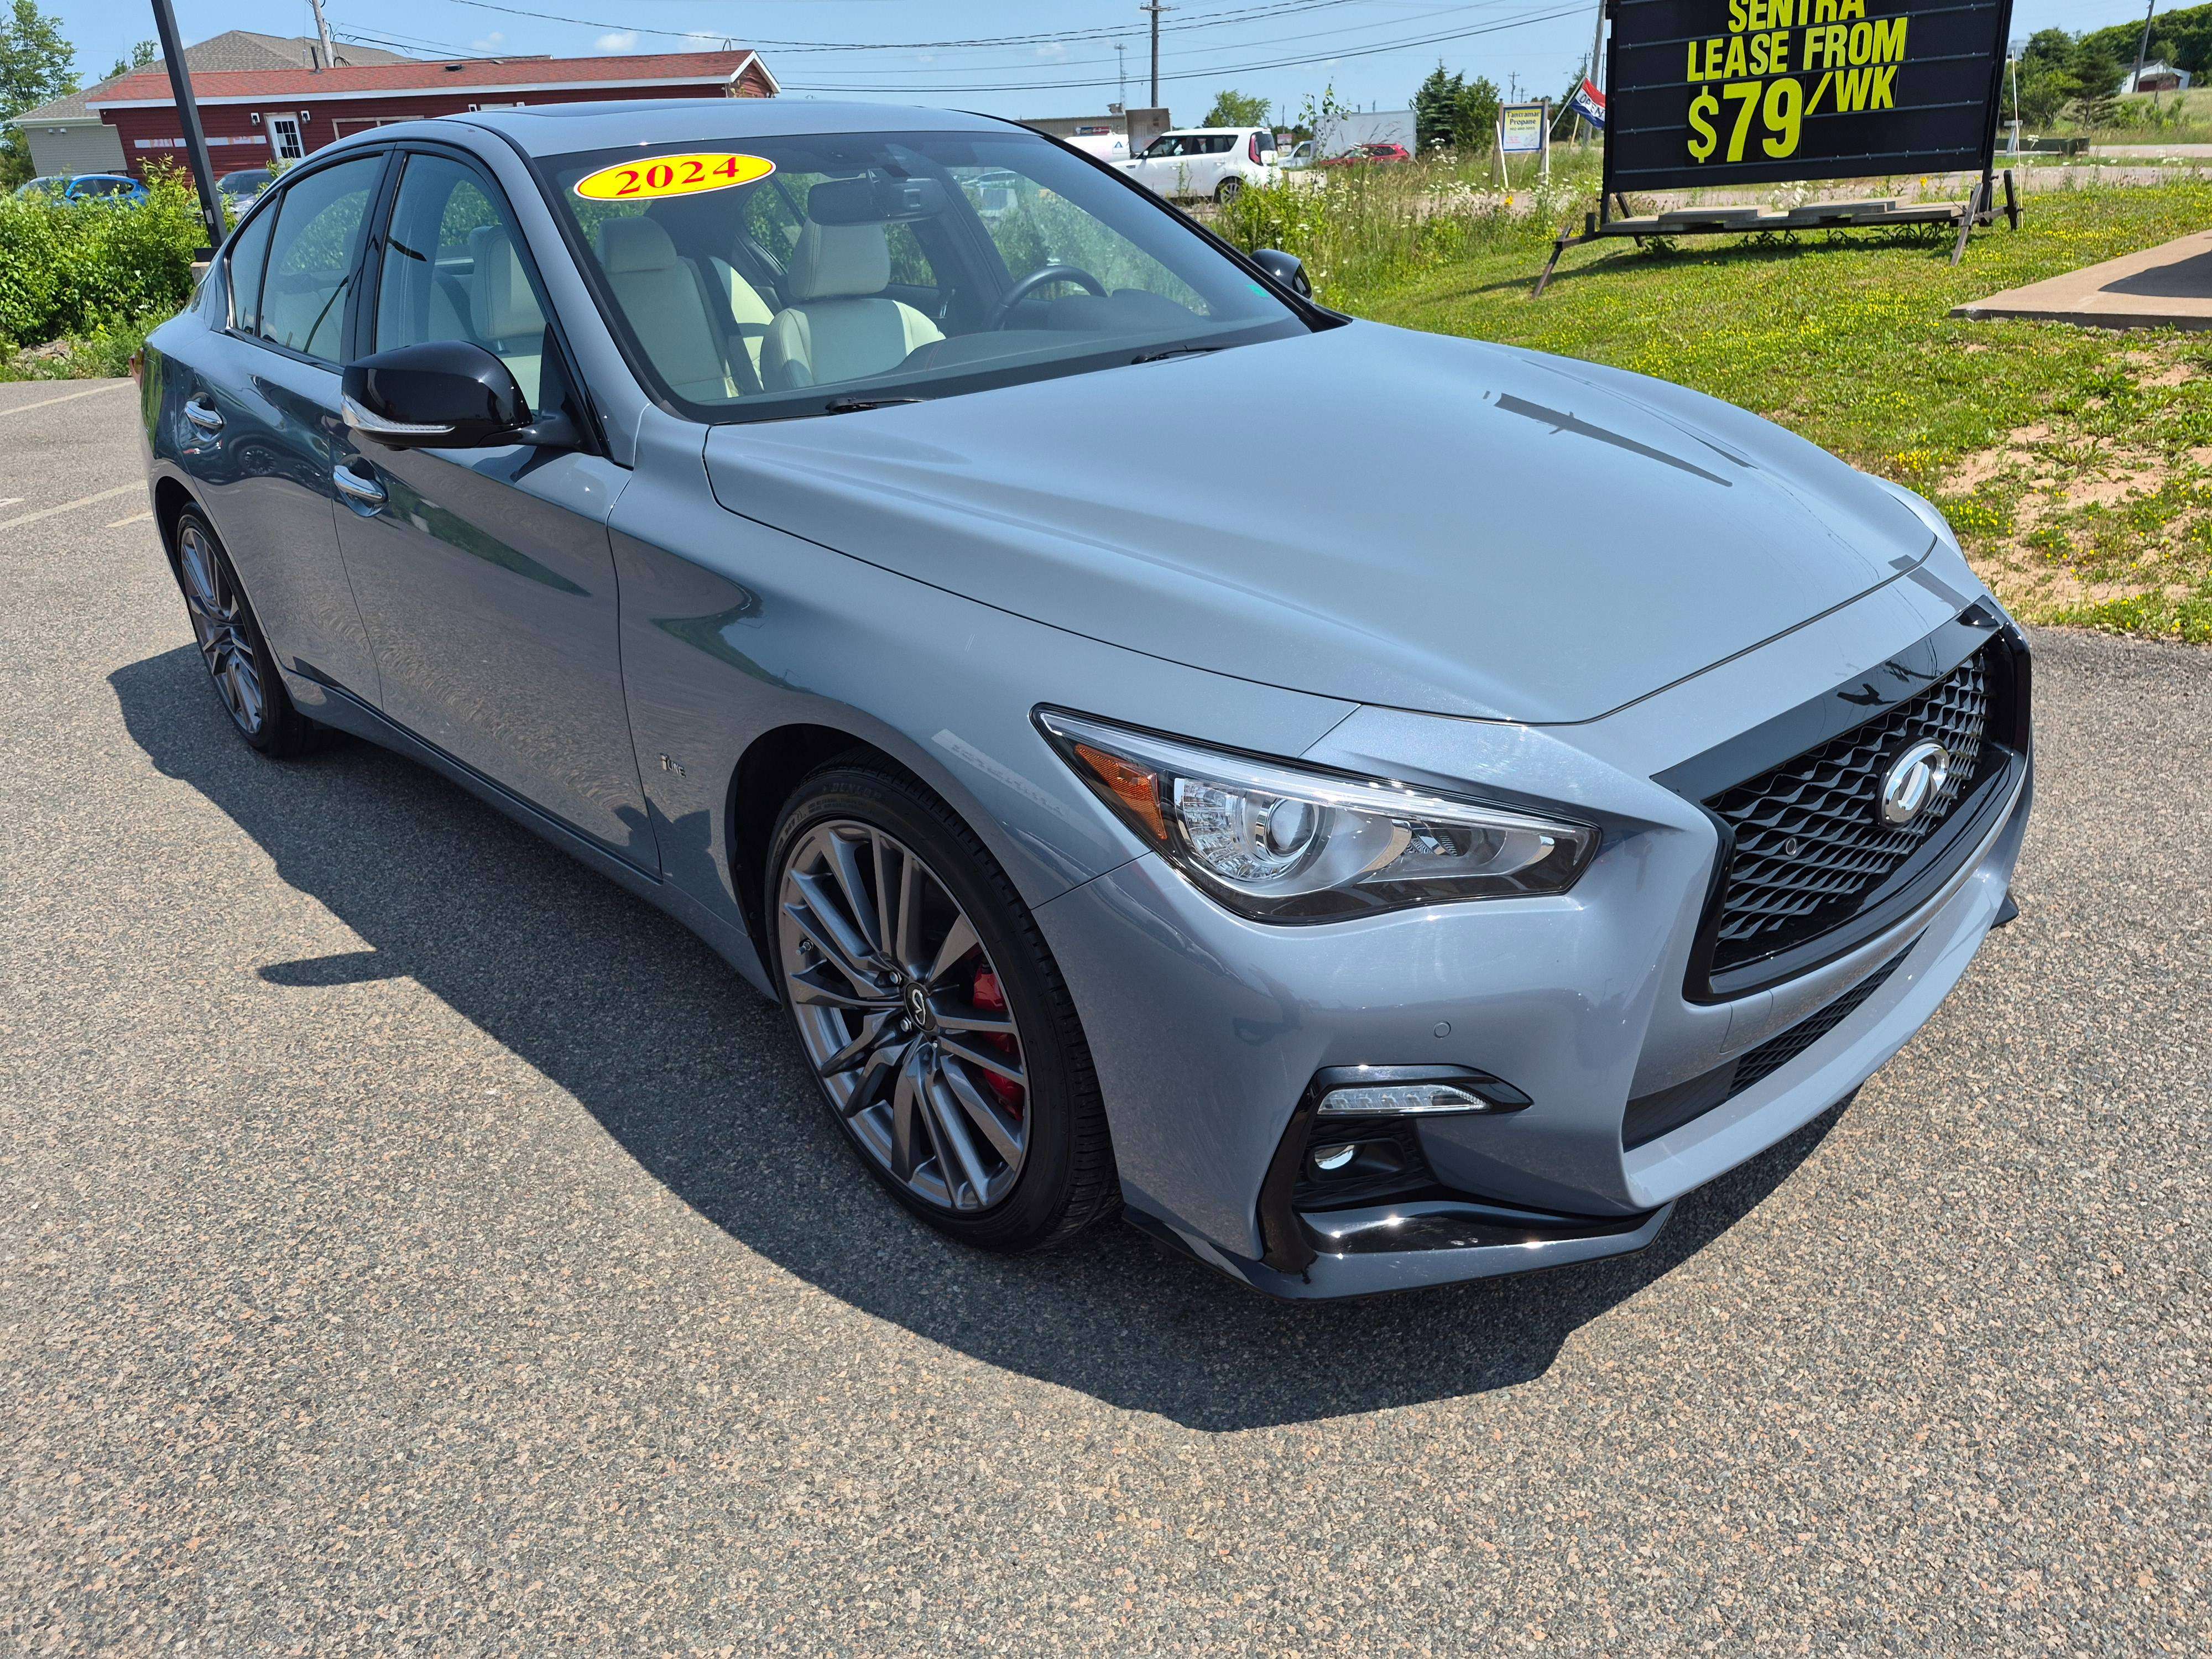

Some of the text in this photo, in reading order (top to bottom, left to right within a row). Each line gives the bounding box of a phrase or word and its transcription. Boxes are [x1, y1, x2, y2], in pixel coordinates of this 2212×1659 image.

[1687, 17, 1908, 82] LEASE FROM
[1579, 93, 1605, 117] OPEN
[614, 156, 740, 196] 2024
